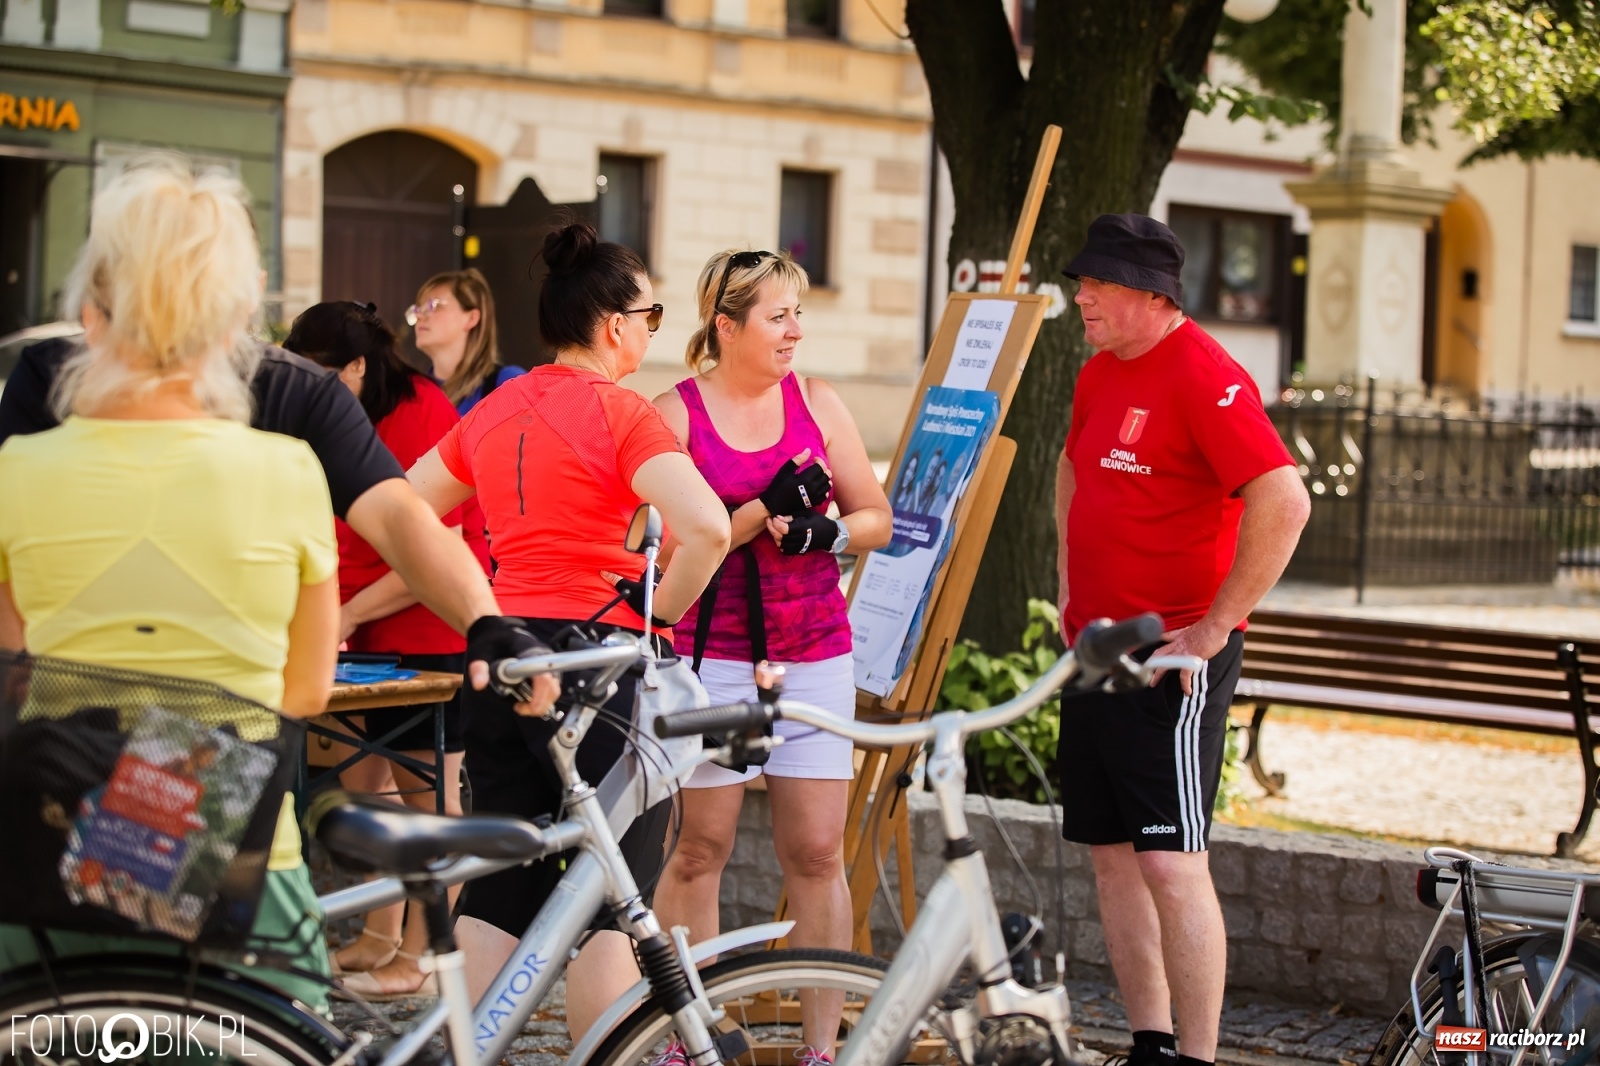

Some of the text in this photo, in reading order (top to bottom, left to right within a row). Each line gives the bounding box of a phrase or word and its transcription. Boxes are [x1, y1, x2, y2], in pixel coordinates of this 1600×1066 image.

[1110, 448, 1136, 463] GMINA
[1100, 457, 1152, 475] KRZANOWICE
[1142, 824, 1177, 834] adidas
[474, 952, 549, 1052] NATOR
